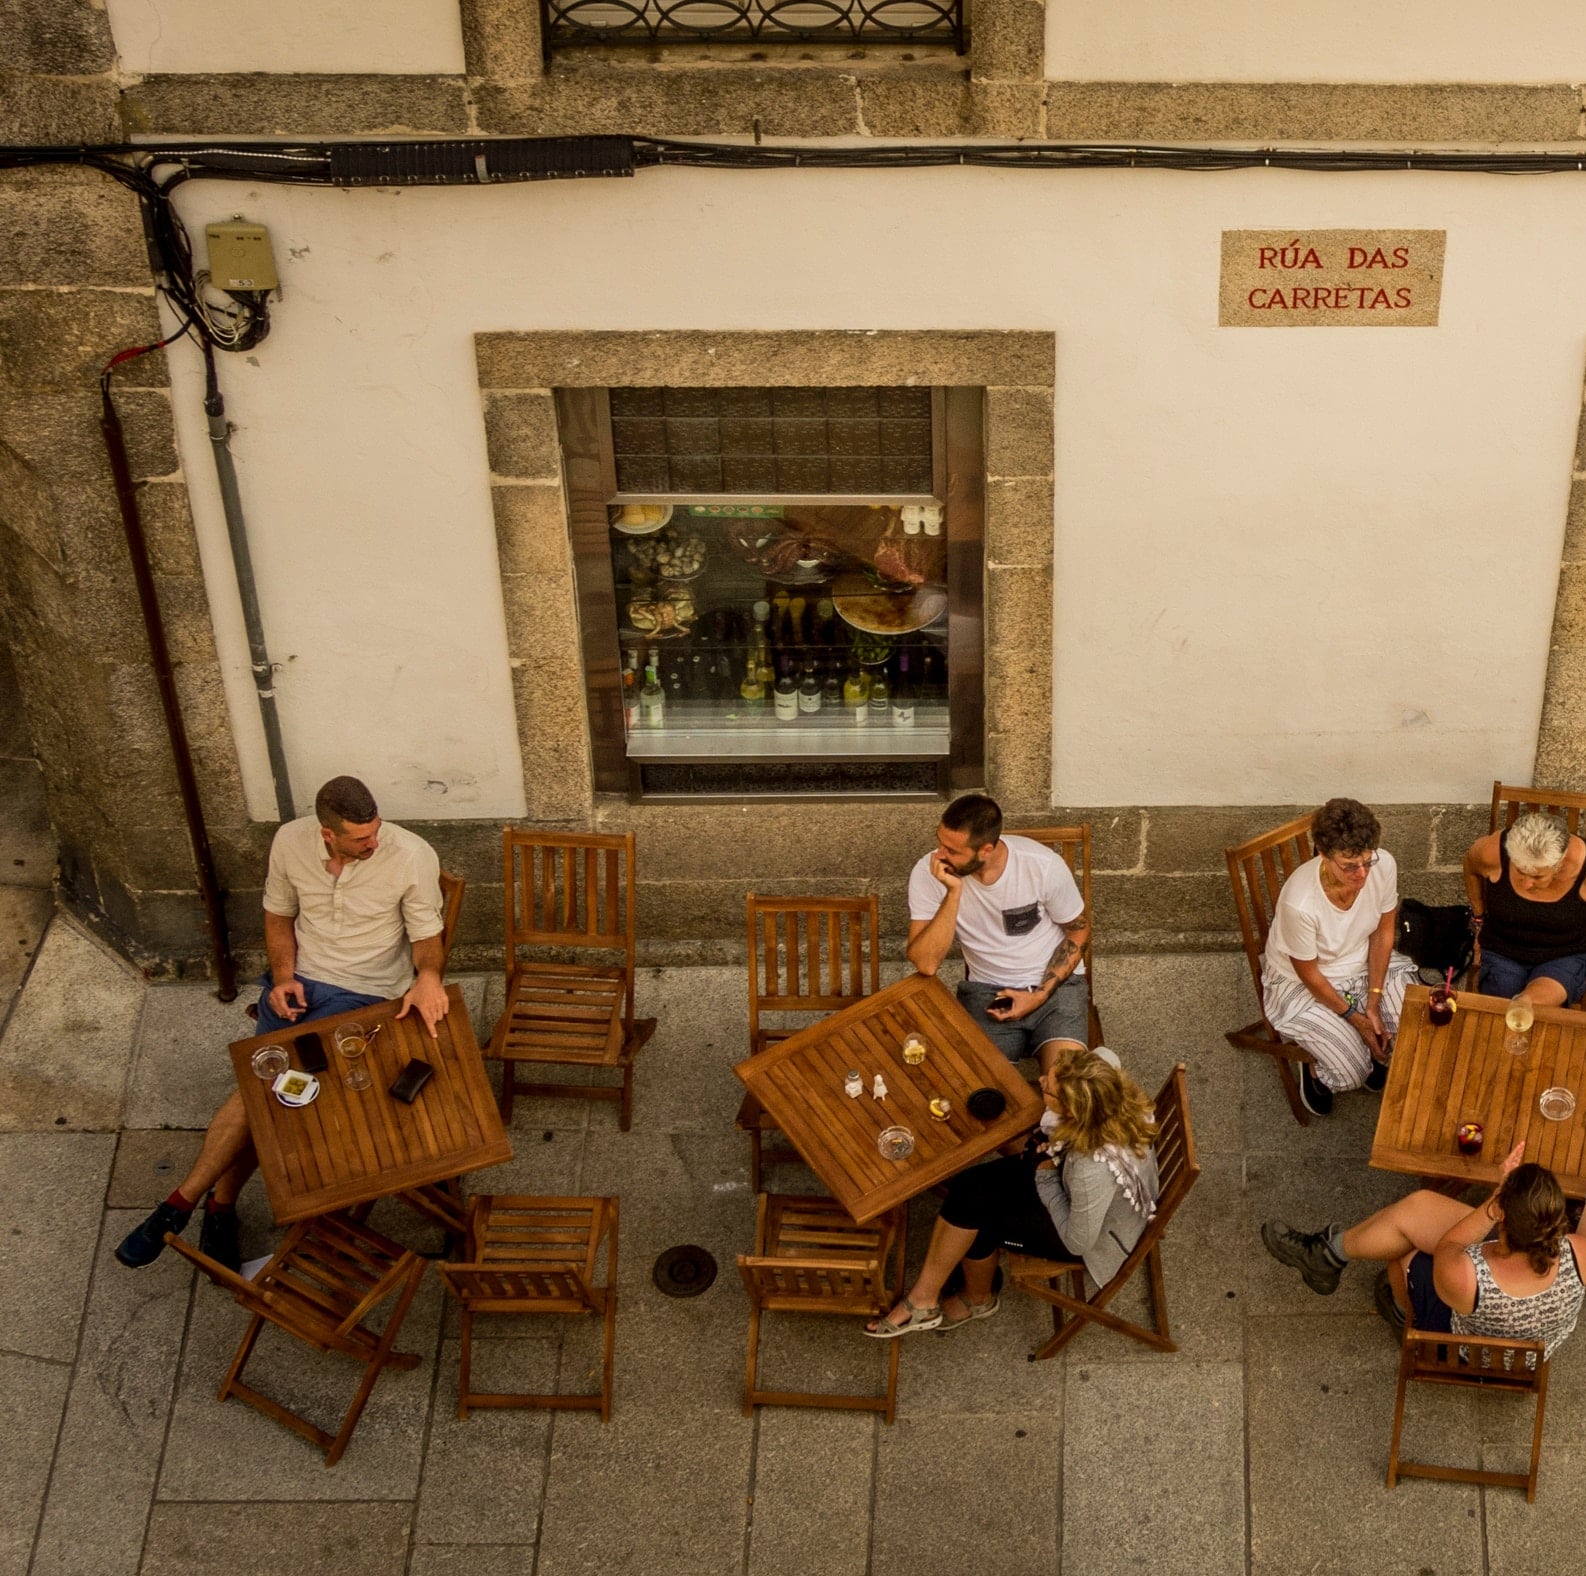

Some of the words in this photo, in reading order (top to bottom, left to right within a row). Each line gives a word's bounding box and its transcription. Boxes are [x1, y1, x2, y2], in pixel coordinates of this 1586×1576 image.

[1258, 238, 1323, 270] RÚA
[1347, 247, 1410, 270] DAS
[1247, 287, 1412, 310] CARRETAS
